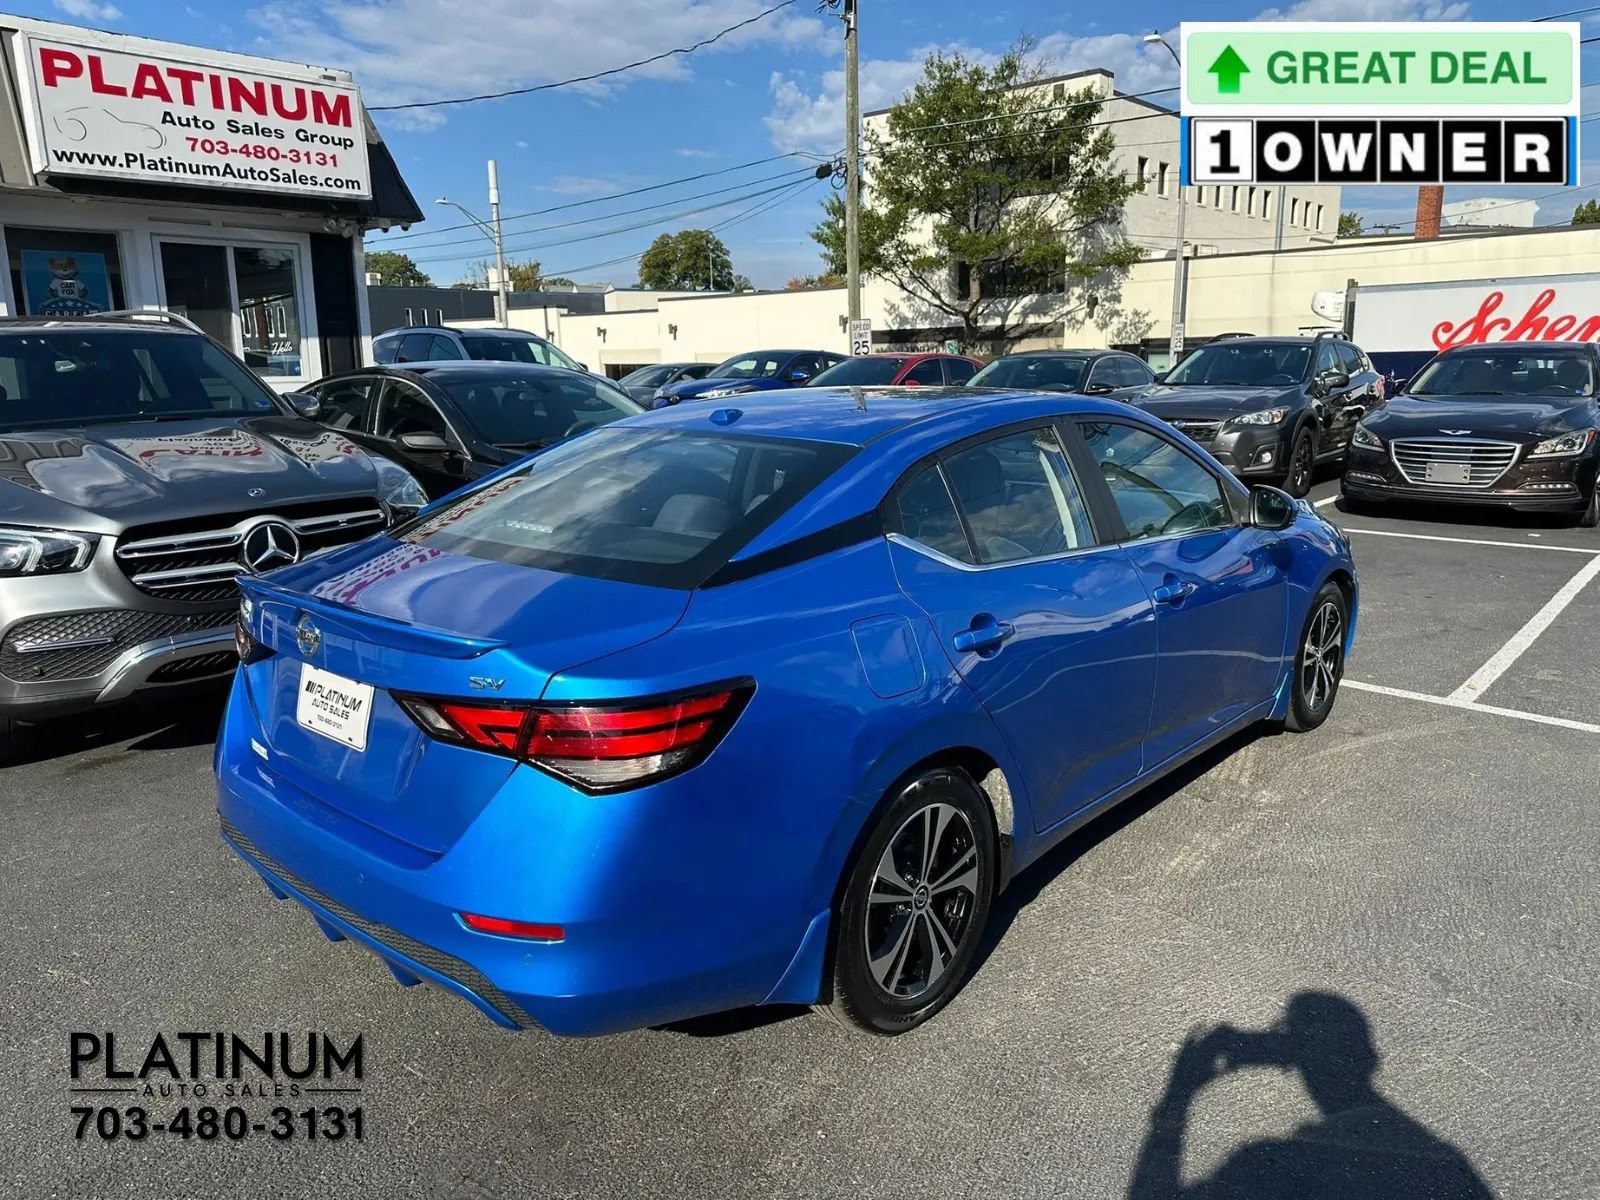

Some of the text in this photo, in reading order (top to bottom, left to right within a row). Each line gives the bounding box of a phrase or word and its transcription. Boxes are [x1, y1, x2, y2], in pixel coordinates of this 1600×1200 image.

[39, 48, 353, 128] PLATINUM
[161, 110, 354, 150] Auto Sales Group
[185, 136, 338, 168] 703-480-3131
[52, 149, 361, 190] www.PlatinumAutoSales.com
[852, 323, 869, 331] SPEED
[271, 341, 293, 356] Hello
[853, 340, 870, 355] 25
[469, 676, 507, 691] SV
[312, 698, 350, 720] AUTO SALES
[315, 684, 362, 713] PLATINUM
